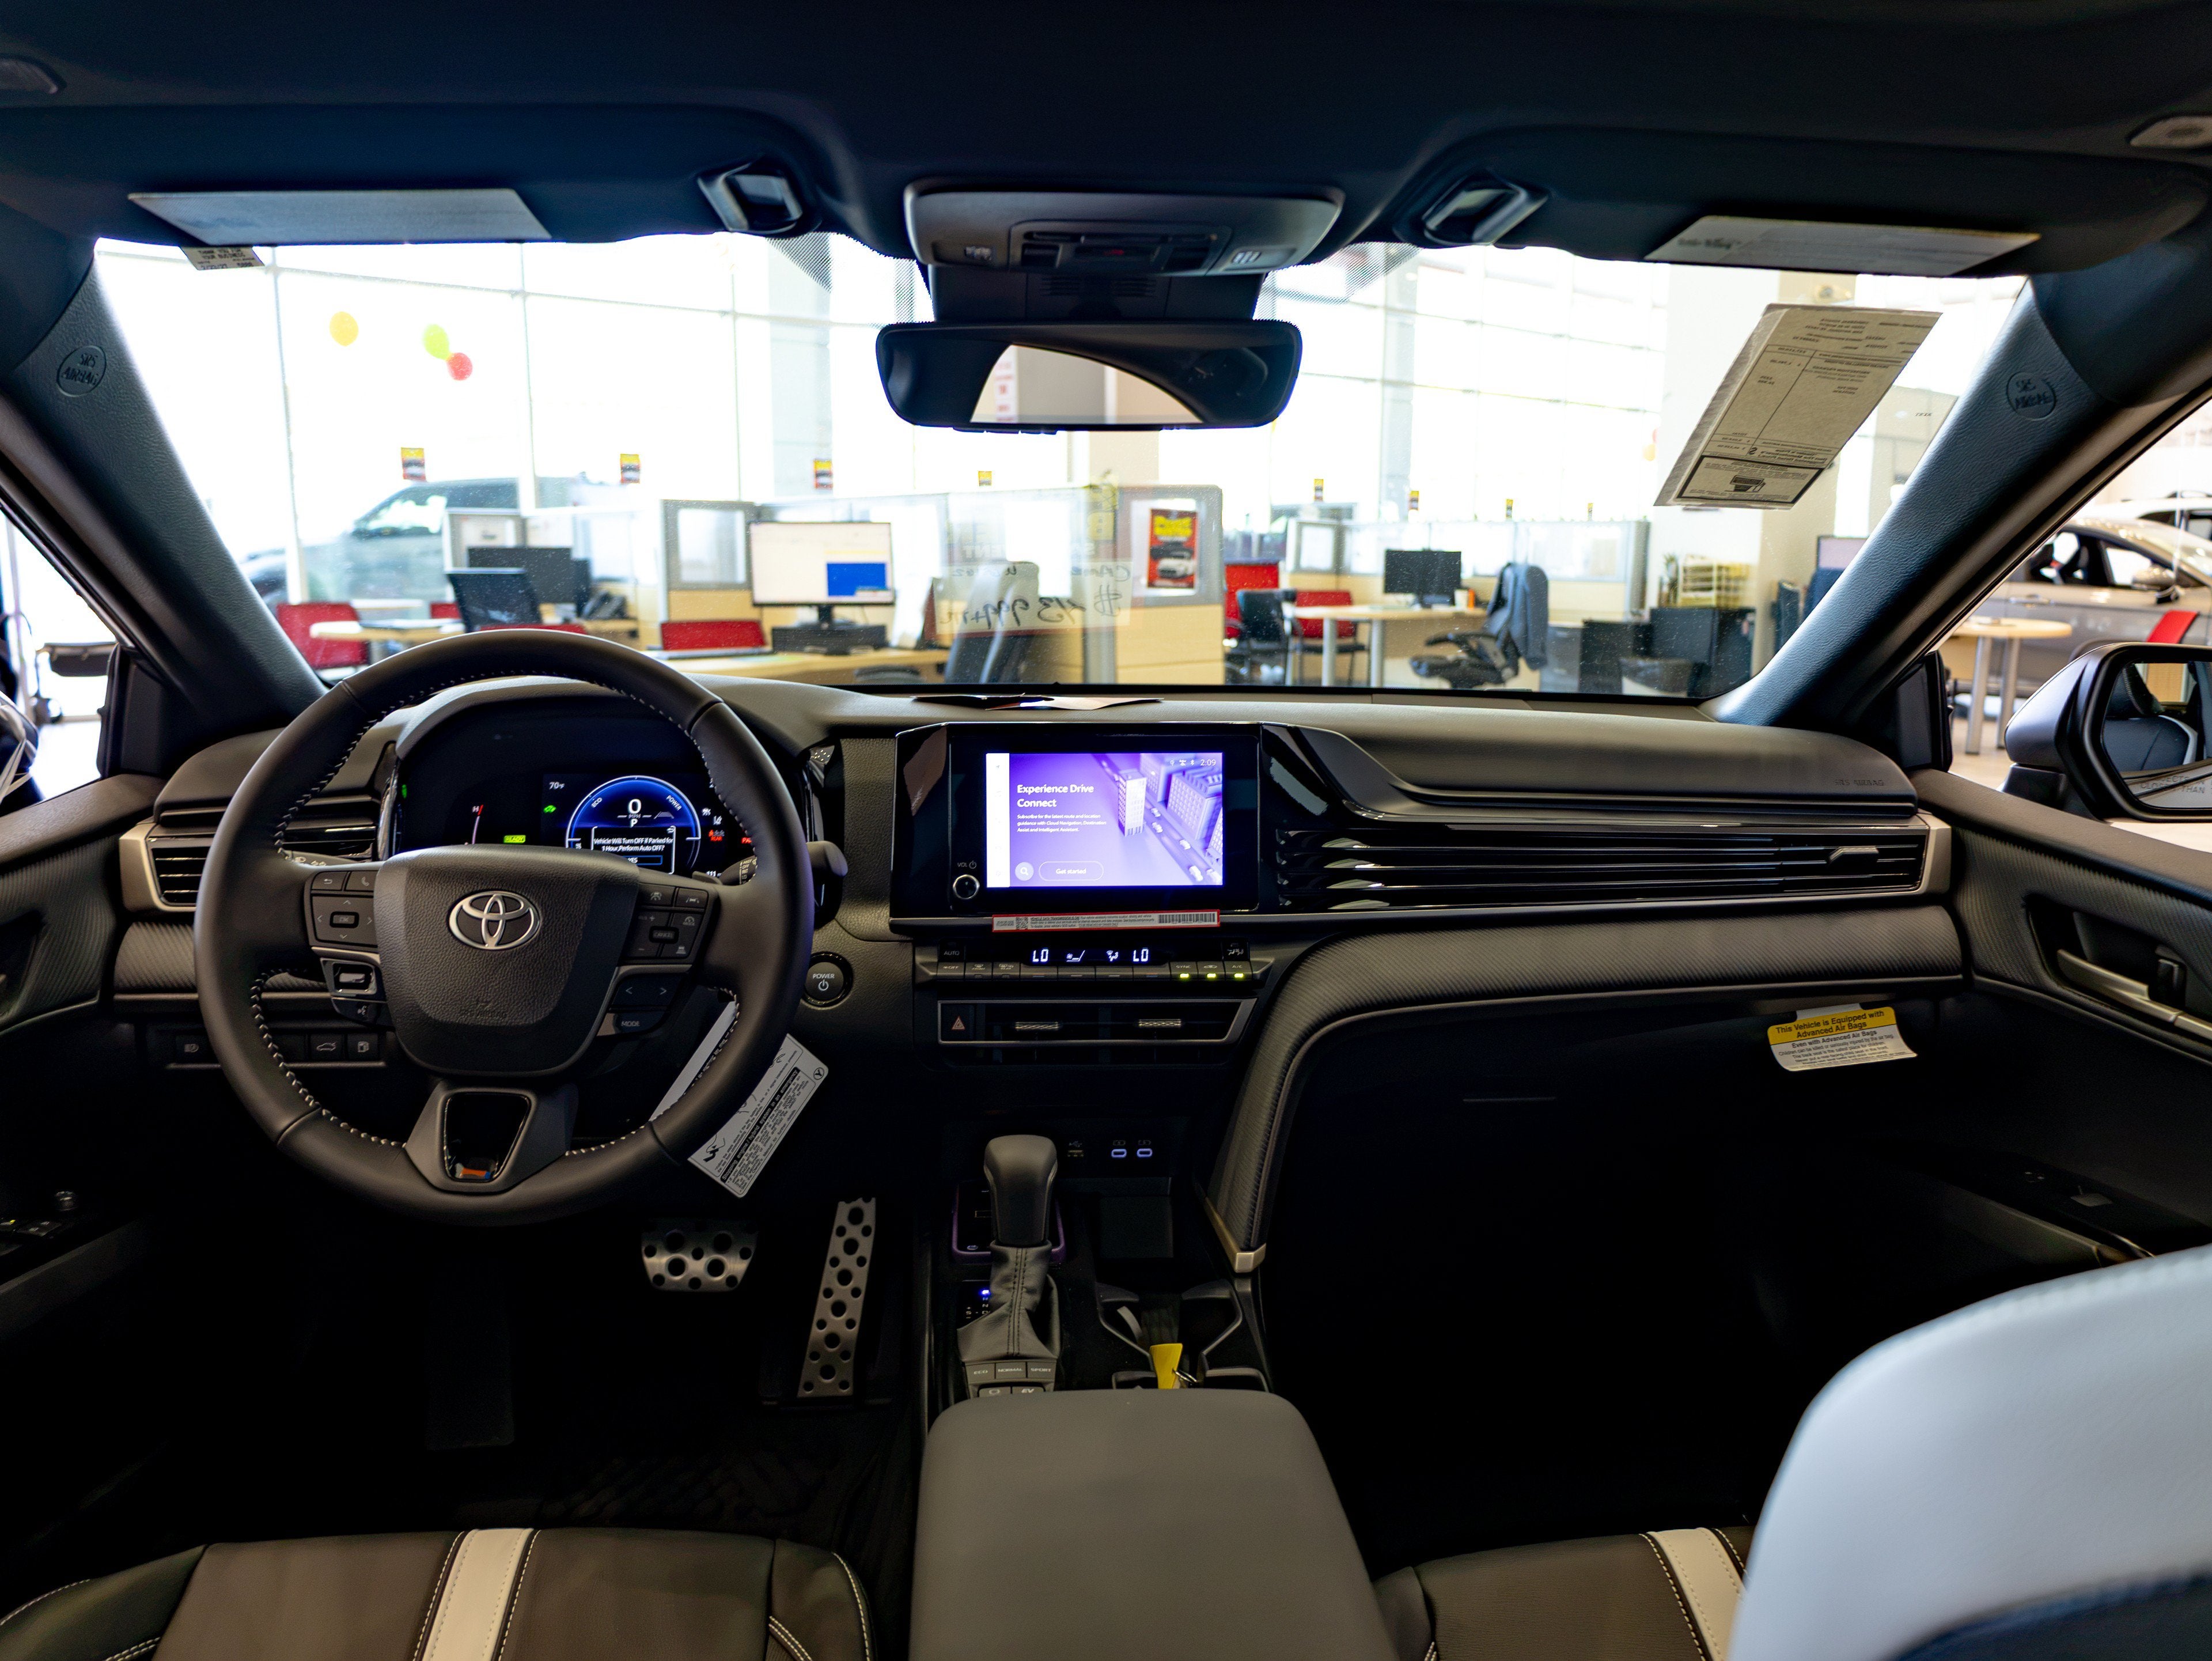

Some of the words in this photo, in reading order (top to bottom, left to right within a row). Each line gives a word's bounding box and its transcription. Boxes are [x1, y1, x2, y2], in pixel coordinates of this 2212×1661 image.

[1017, 784, 1068, 795] Experience
[1070, 784, 1094, 793] Drive
[591, 797, 603, 808] ECO
[628, 799, 642, 814] 0
[666, 794, 683, 811] POWER
[1017, 799, 1057, 808] Connect
[630, 819, 638, 828] P
[1032, 948, 1048, 962] LO
[1132, 948, 1149, 962] LO
[1776, 1025, 1792, 1034] This
[1794, 1021, 1821, 1031] Vehicle
[1831, 1013, 1867, 1025] Equipped
[1868, 1010, 1884, 1019] with
[1797, 1026, 1834, 1038] Advanced
[1848, 1021, 1867, 1030] Bags
[1821, 1034, 1851, 1044] Advanced
[815, 1069, 824, 1078] Y
[721, 1159, 738, 1181] Stopping
[748, 1125, 761, 1141] hybrid
[759, 1107, 772, 1125] system
[779, 1069, 799, 1094] emergency
